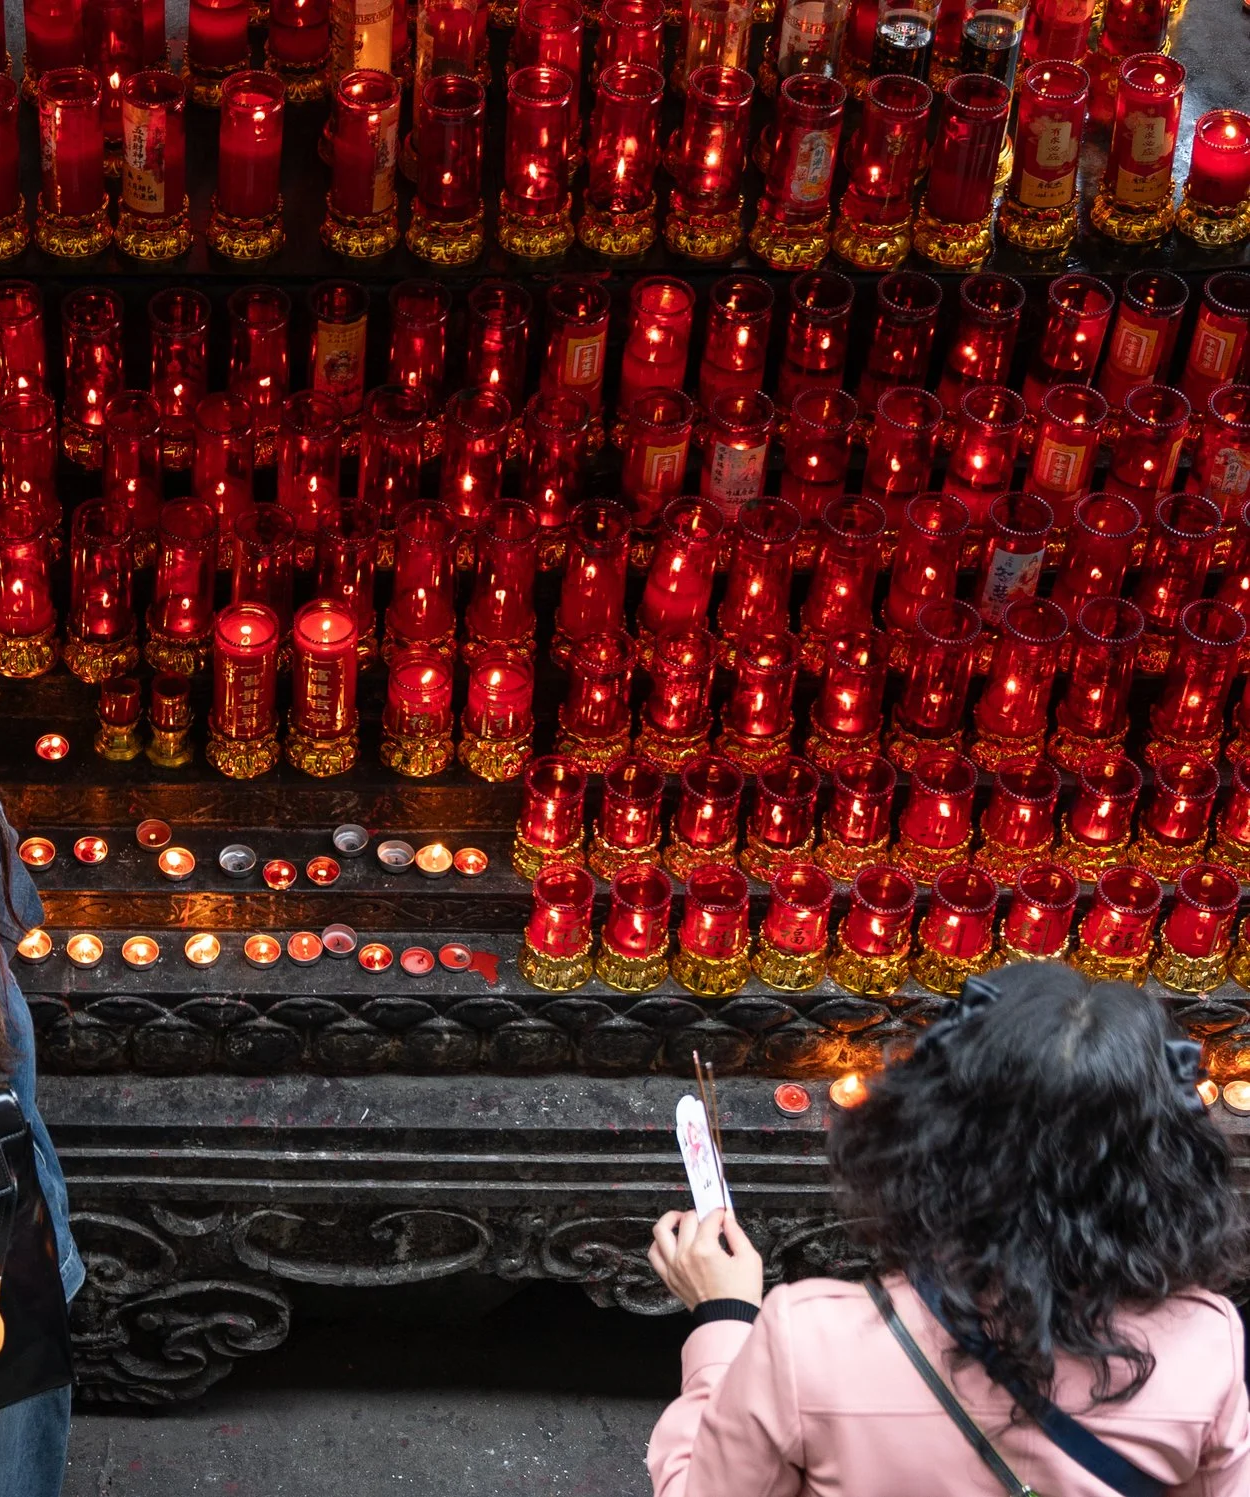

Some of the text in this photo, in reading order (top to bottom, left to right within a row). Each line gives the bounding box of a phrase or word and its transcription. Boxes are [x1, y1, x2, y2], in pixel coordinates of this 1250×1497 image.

[1045, 126, 1062, 161] 有求必应
[1140, 122, 1156, 156] 有求必应
